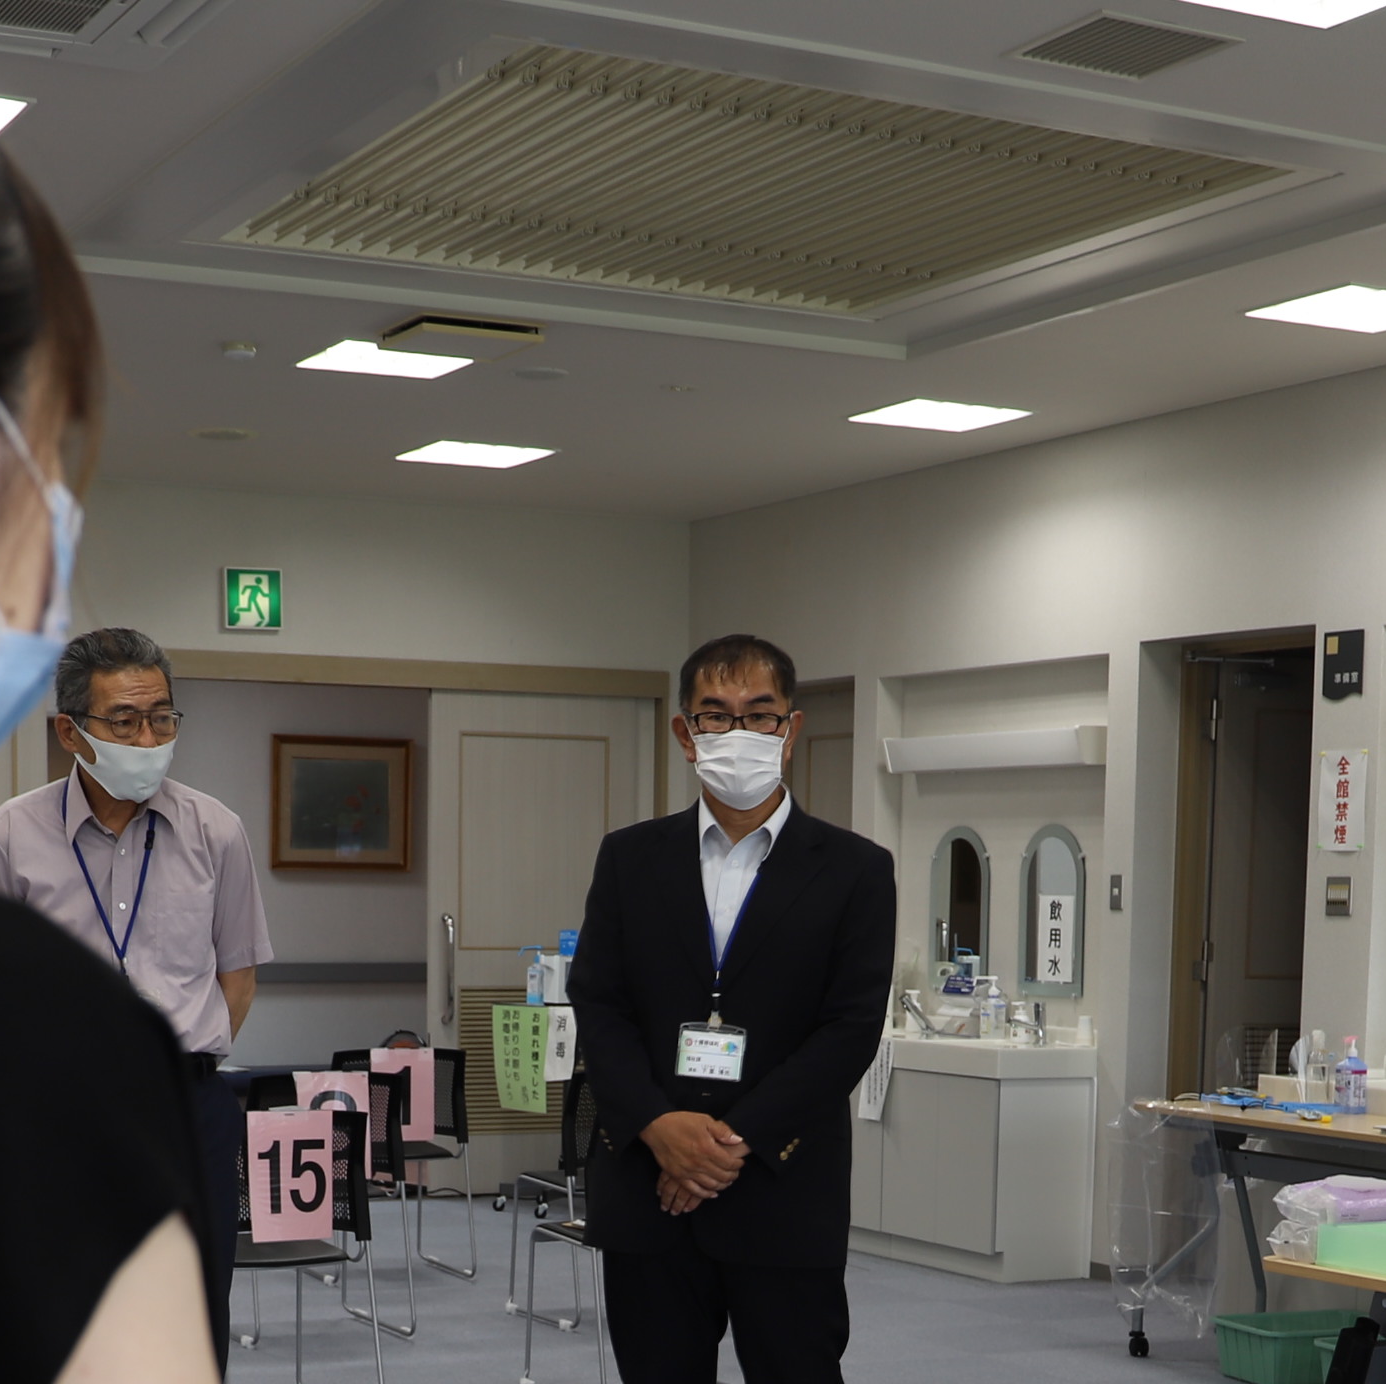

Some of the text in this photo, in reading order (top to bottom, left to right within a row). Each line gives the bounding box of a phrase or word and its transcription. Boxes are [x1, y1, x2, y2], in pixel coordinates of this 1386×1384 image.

[1334, 756, 1350, 844] 全館禁煙
[1047, 900, 1062, 976] 飲用水
[531, 1013, 541, 1100] お疲れ様でした
[556, 1015, 567, 1058] 消毒
[258, 1139, 326, 1214] 15
